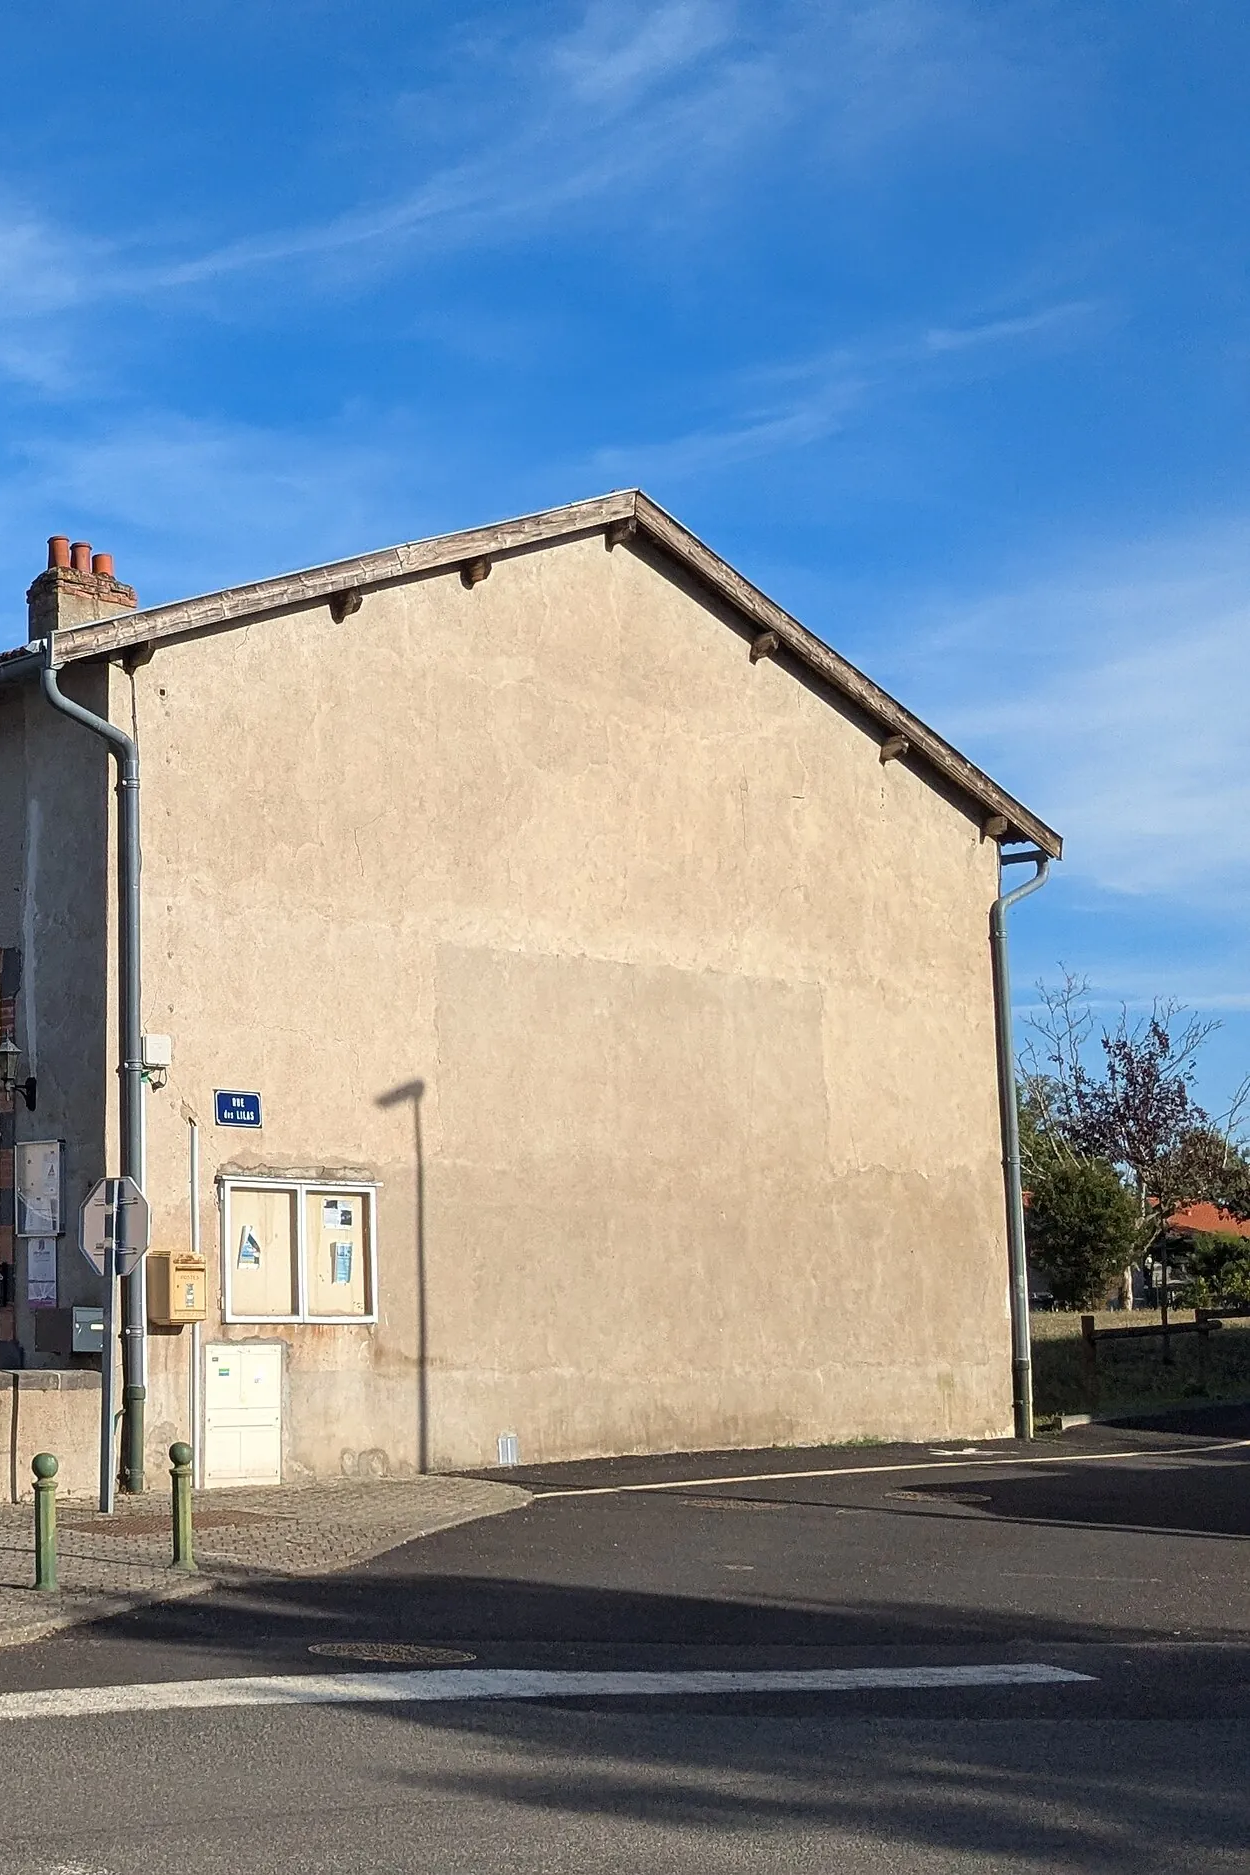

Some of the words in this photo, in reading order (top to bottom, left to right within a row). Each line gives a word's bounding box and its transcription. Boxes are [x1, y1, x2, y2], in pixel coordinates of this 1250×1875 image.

[232, 1097, 245, 1108] RUE
[223, 1109, 234, 1119] des
[236, 1110, 255, 1121] LILAS
